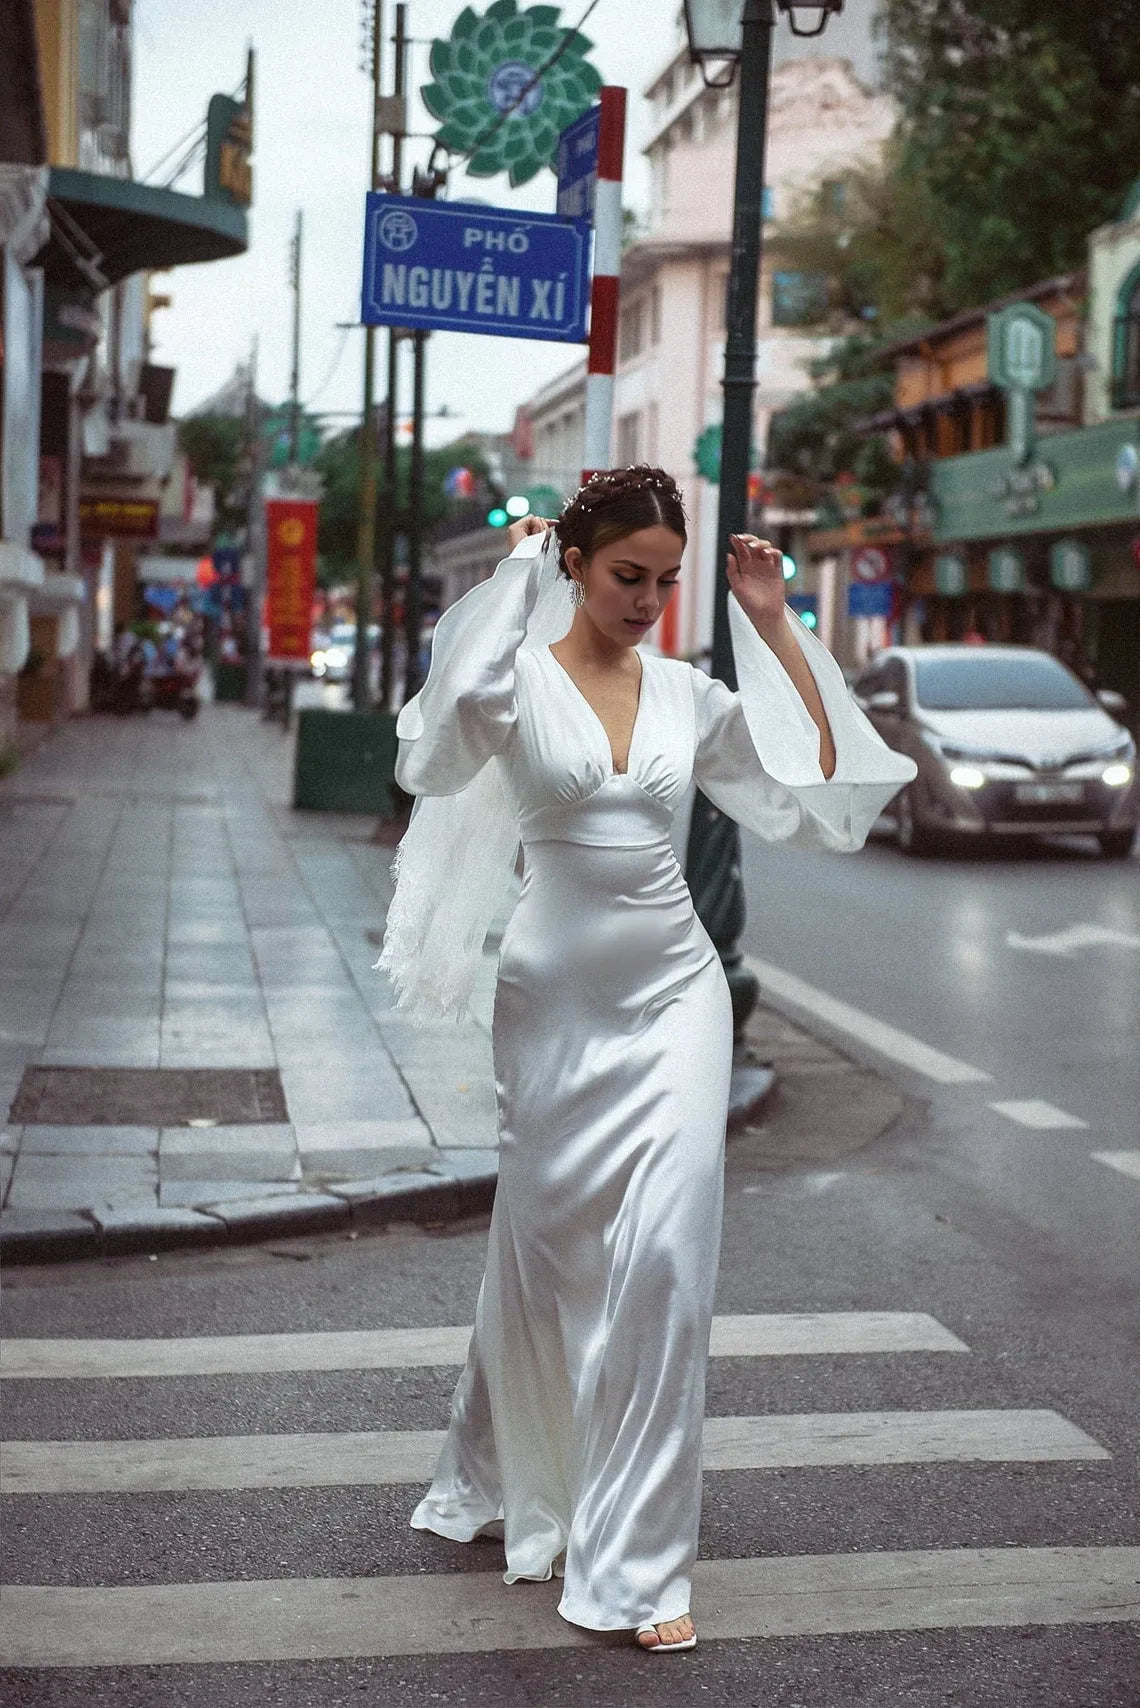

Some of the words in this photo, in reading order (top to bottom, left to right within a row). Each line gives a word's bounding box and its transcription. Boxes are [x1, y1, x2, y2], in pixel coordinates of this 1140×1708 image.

[463, 224, 530, 253] PHỐ
[383, 257, 520, 317] NGUYỄN
[530, 273, 567, 321] XÍ
